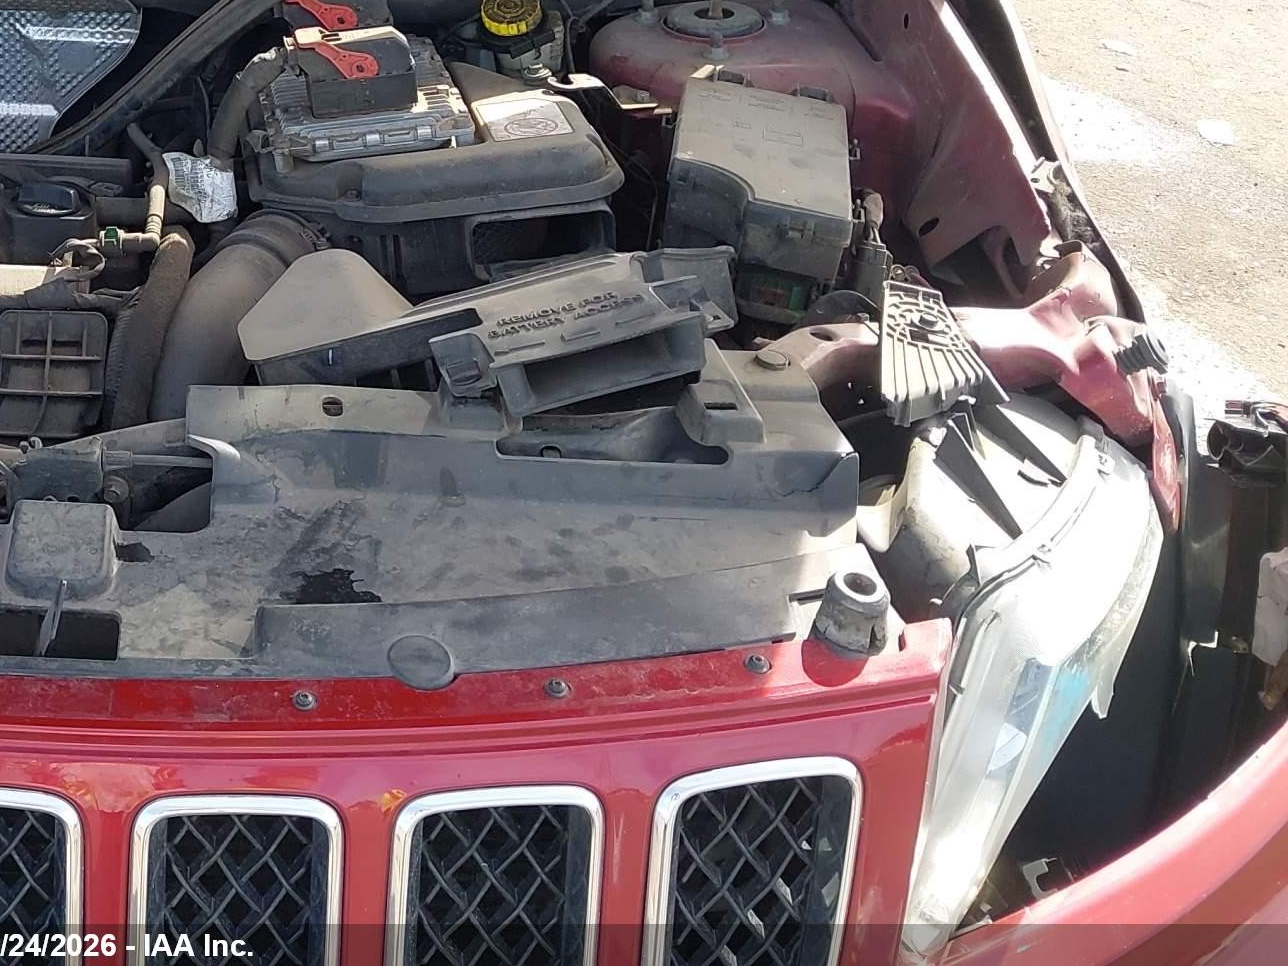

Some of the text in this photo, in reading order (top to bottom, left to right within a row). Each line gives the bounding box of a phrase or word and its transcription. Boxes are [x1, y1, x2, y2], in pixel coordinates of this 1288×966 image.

[487, 293, 646, 340] BATTERY ACCESS
[495, 291, 618, 328] REMOVE FOR
